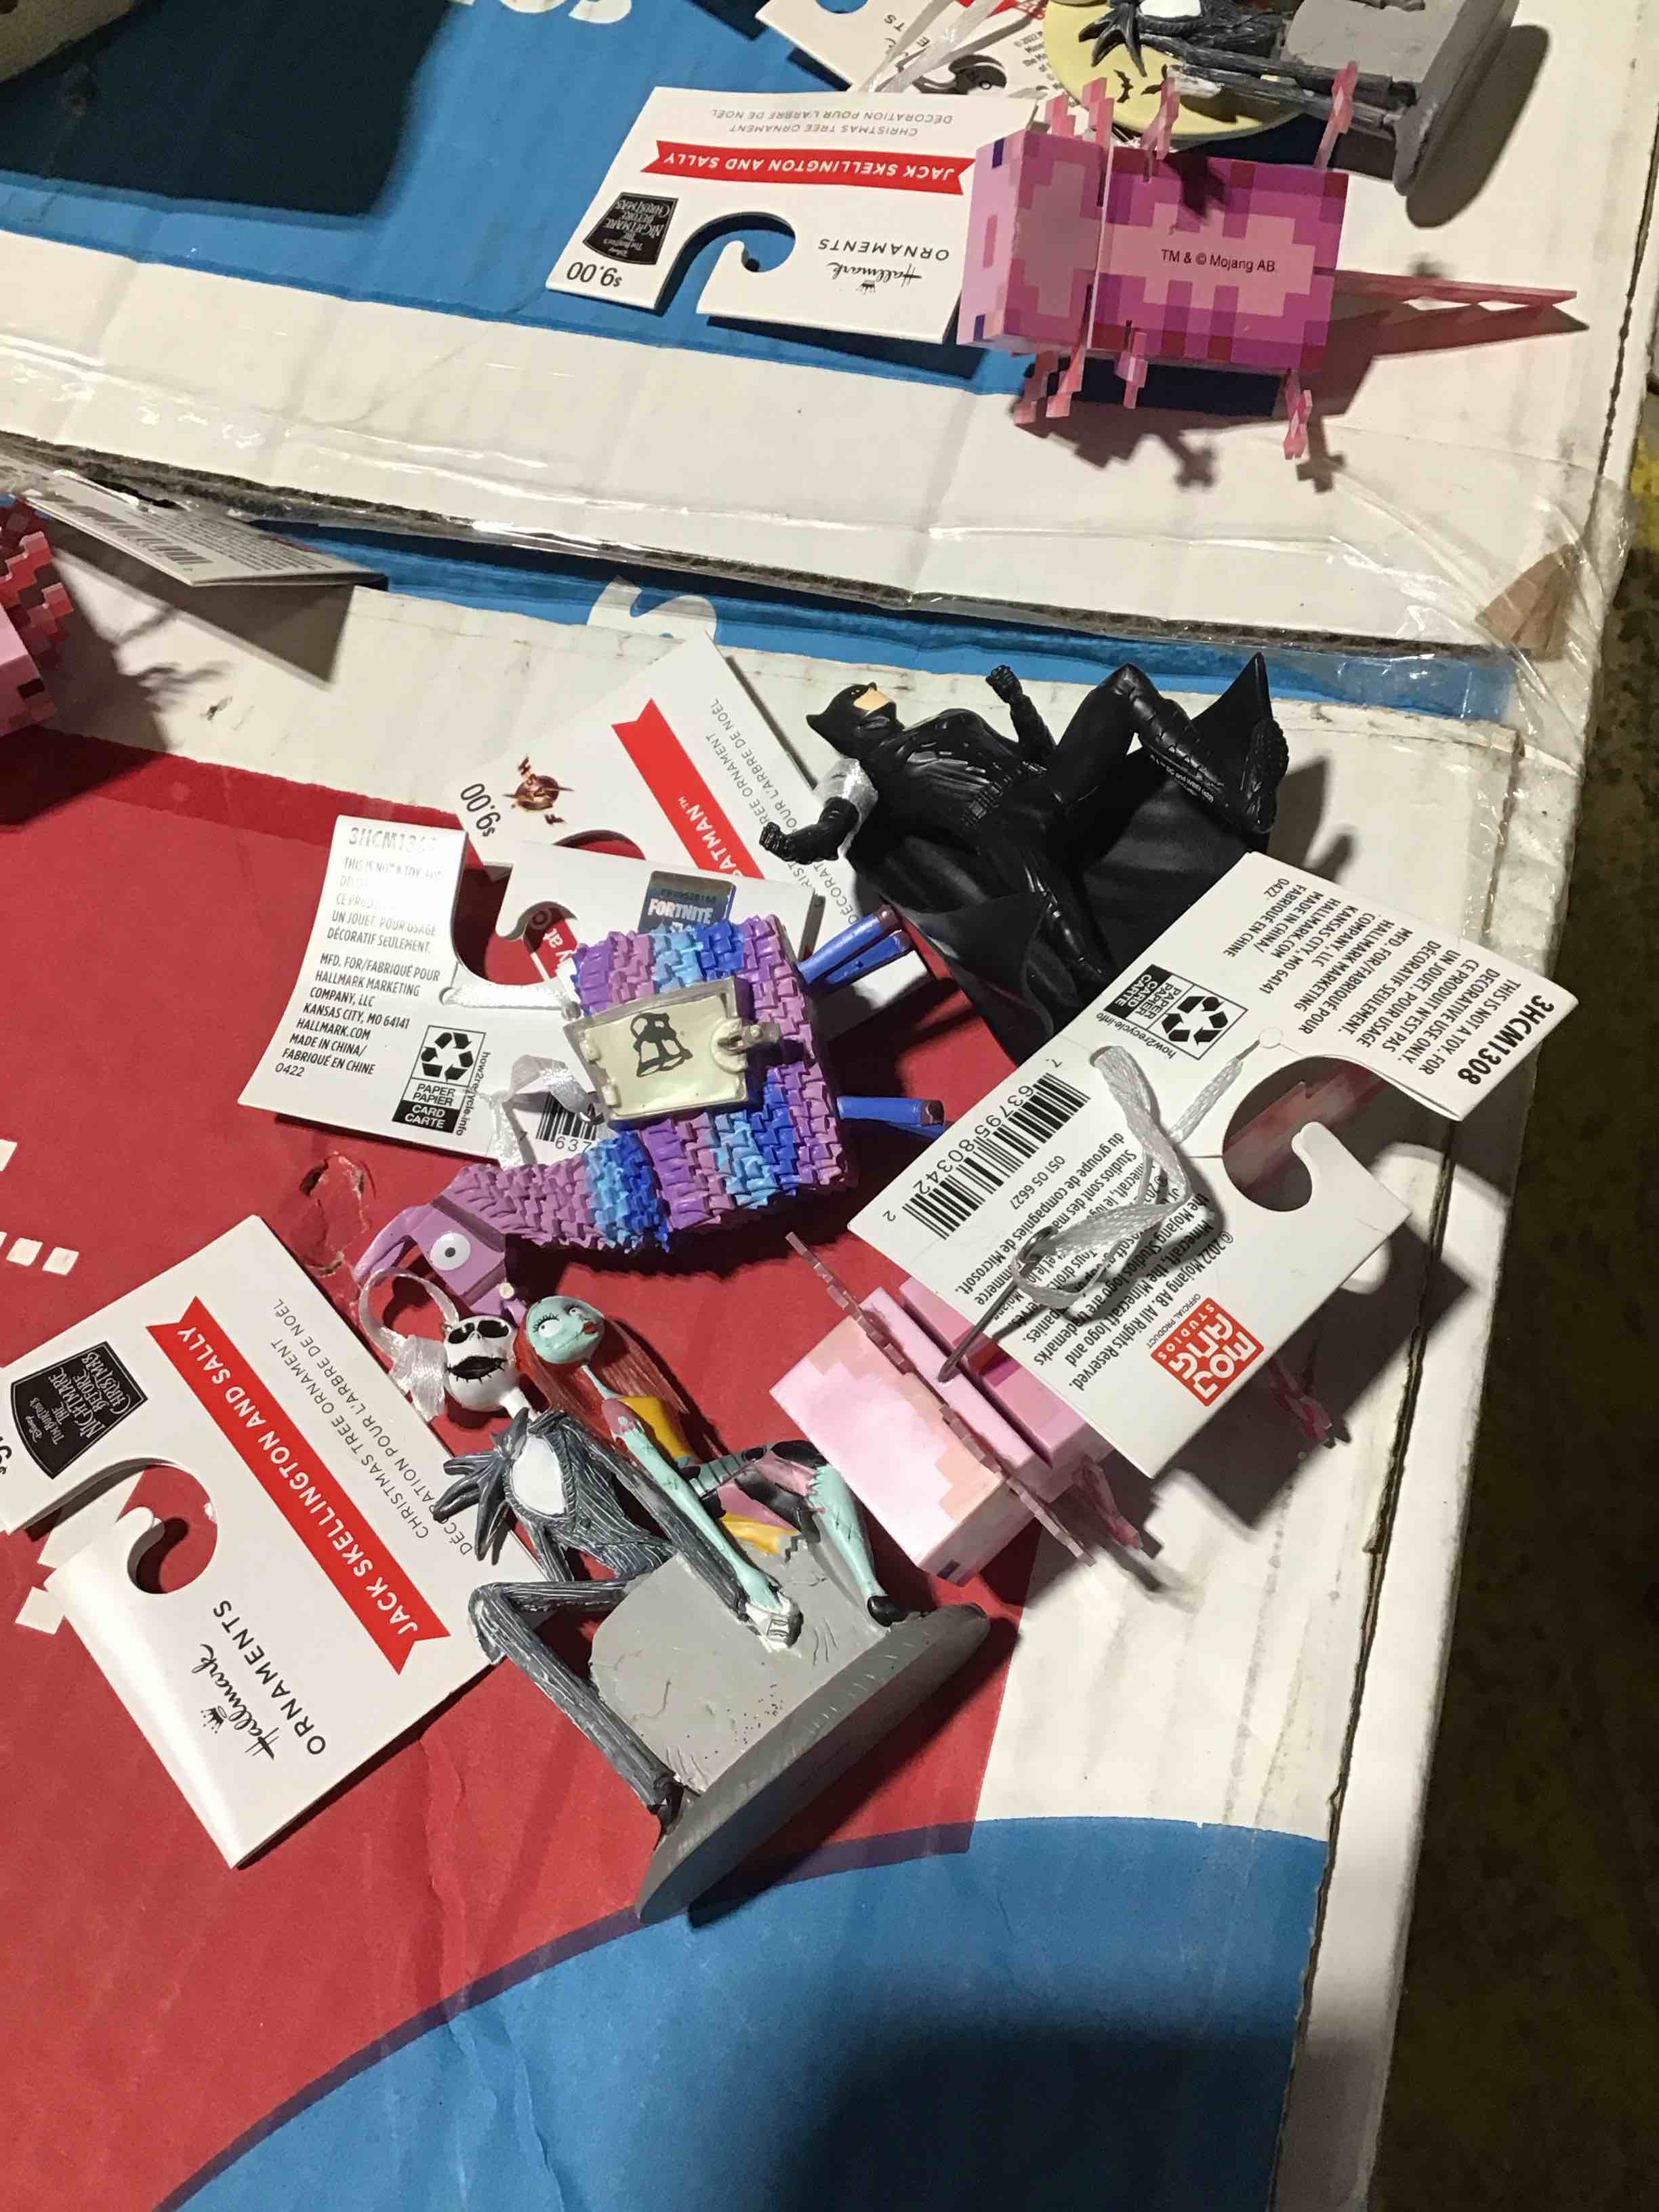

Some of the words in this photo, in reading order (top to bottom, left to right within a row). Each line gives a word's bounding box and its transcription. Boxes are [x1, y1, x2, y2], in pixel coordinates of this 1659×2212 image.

[804, 124, 835, 132] TREE
[823, 110, 860, 119] POUR
[729, 124, 800, 133] ORNAMENT
[840, 125, 918, 136] CHRISTMAS
[663, 152, 720, 168] SALLY
[725, 159, 764, 170] AND
[768, 160, 898, 176] SKELLINGTON
[903, 165, 954, 180] JACK
[819, 239, 949, 261] ORNAMENTS
[1162, 249, 1180, 262] TM
[1183, 252, 1191, 264] &
[1210, 255, 1254, 273] Mojang
[567, 262, 622, 287] $9.00
[828, 262, 922, 286] Hallmark
[711, 699, 733, 731] NOËL
[729, 731, 746, 748] DE
[705, 734, 753, 797] ORNAMENT
[741, 749, 779, 798] L'ARBRE
[460, 783, 501, 837] $9.00
[1264, 878, 1290, 897] 0422
[648, 899, 713, 924] FORTNITE
[1261, 884, 1307, 923] FABRIQUÉ
[1293, 891, 1324, 915] MADE
[331, 909, 346, 923] UN
[378, 916, 406, 933] POUR
[1248, 921, 1267, 934] EN
[1271, 895, 1341, 958] HALLMARK.COM
[1284, 913, 1300, 924] IN
[1318, 905, 1358, 937] KANSAS
[1325, 909, 1375, 951] COMPANY,
[327, 927, 376, 945] DÉCORATIF
[1223, 933, 1254, 957] CHINE
[1254, 921, 1288, 953] CHINA/
[1295, 937, 1324, 961] CITY,
[1342, 920, 1395, 964] HALLMARK
[1385, 928, 1413, 946] MFD.
[320, 953, 341, 966] MFD.
[344, 956, 413, 977] FOR/FABRIQUÉ
[413, 966, 441, 981] POUR
[1284, 956, 1304, 970] MO
[1311, 951, 1334, 967] LLC
[1390, 941, 1441, 987] DÉCORATIF
[1439, 950, 1461, 965] UN
[1460, 960, 1479, 977] CE
[315, 970, 365, 987] HALLMARK
[366, 978, 420, 996] MARKETING
[1115, 968, 1151, 1006] CARTE
[1259, 969, 1288, 994] 64141
[1294, 961, 1349, 1012] MARKETING
[1323, 947, 1392, 1011] FOR/FABRIQUÉ
[1410, 962, 1446, 992] JOUET.
[1424, 969, 1469, 1010] PRODUIT
[1493, 979, 1521, 1002] THIS
[310, 987, 355, 1006] COMPANY,
[358, 995, 375, 1007] LLC
[1128, 976, 1158, 1007] CARD
[1135, 977, 1174, 1017] PAPIER
[1143, 984, 1182, 1019] PAPER
[1385, 991, 1418, 1018] POUR
[1440, 968, 1500, 1023] DECORATIVE
[1483, 998, 1501, 1011] IS
[303, 1003, 340, 1018] KANSAS
[342, 1009, 364, 1024] CITY,
[367, 1013, 382, 1025] MO
[383, 1015, 410, 1029] 64141
[1298, 1007, 1330, 1034] POUR
[1338, 984, 1396, 1035] SEULEMENT.
[1400, 1007, 1431, 1035] N'EST
[1465, 1008, 1492, 1029] NOT
[296, 1018, 371, 1040] HALLMARK.COM
[1096, 1010, 1178, 1060] how2recycle.info
[1356, 1017, 1393, 1048] USAGE
[1382, 1031, 1407, 1052] PAS
[1423, 1020, 1449, 1040] USE
[1456, 1025, 1472, 1041] A
[1458, 996, 1555, 1084] 3HCM1308
[289, 1033, 319, 1047] MADE
[319, 1038, 331, 1049] IN
[331, 1041, 367, 1057] CHINA/
[1398, 1038, 1431, 1064] ONLY.
[1437, 1035, 1466, 1054] TOY.
[275, 1063, 305, 1077] 0422
[282, 1048, 331, 1066] FABRIQUÉ
[331, 1057, 346, 1069] EN
[346, 1060, 375, 1075] CHINE
[1418, 1054, 1446, 1075] FOR
[413, 1092, 453, 1106] PAPIER
[417, 1083, 455, 1097] PAPER
[405, 1112, 445, 1128] CARTE
[412, 1105, 445, 1118] CARD
[970, 1076, 1037, 1145] 63795
[1107, 1133, 1124, 1147] du
[911, 1132, 976, 1200] 80342
[1045, 1155, 1065, 1174] 051
[1076, 1143, 1111, 1177] groupe
[1100, 1149, 1136, 1182] Studios
[1031, 1172, 1048, 1187] 05
[1064, 1175, 1080, 1189] de
[1081, 1179, 1104, 1202] sont
[1010, 1185, 1035, 1210] 6627
[1066, 1198, 1086, 1216] des
[1185, 1190, 1210, 1216] the
[880, 1208, 898, 1225] 2
[1012, 1187, 1068, 1241] compagnies
[1151, 1203, 1195, 1249] Mojang
[1000, 1239, 1017, 1252] de
[1159, 1215, 1216, 1273] Minecraft,
[1195, 1235, 1227, 1267] 2022
[955, 1250, 1006, 1294] Microsoft.
[1120, 1237, 1164, 1282] Studios
[1098, 1268, 1132, 1303] logo
[1144, 1260, 1170, 1287] the
[1163, 1253, 1207, 1298] Mojang
[1084, 1292, 1107, 1316] are
[1103, 1277, 1153, 1330] Minecraft
[1149, 1287, 1175, 1313] AB.
[1173, 1293, 1201, 1319] OFFICIAL
[274, 1298, 304, 1336] NOËL
[1137, 1303, 1160, 1326] All
[1030, 1307, 1092, 1372] trademarks
[1080, 1317, 1113, 1351] logo
[1108, 1313, 1147, 1354] Rights
[1146, 1319, 1176, 1349] PRODUCT
[1158, 1297, 1214, 1365] STUDIOS
[178, 1327, 230, 1384] SALLY
[300, 1336, 321, 1357] DE
[1063, 1341, 1090, 1370] and
[81, 1347, 131, 1414] CHRISTMAS
[271, 1339, 334, 1414] ORNAMENT
[1067, 1342, 1120, 1397] Reserved.
[69, 1367, 112, 1414] BEFORE
[316, 1357, 366, 1414] L'ARBRE
[48, 1367, 106, 1438] NIGHTMARE
[52, 1401, 70, 1425] THE
[225, 1387, 266, 1427] AND
[331, 1415, 363, 1454] TREE
[363, 1415, 398, 1457] POUR
[258, 1431, 373, 1576] SKELLINGTON
[361, 1454, 428, 1538] CHRISTMAS
[366, 1577, 417, 1634] JACK
[213, 1601, 325, 1755] ORNAMENTS
[192, 1644, 279, 1759] Hallmark
